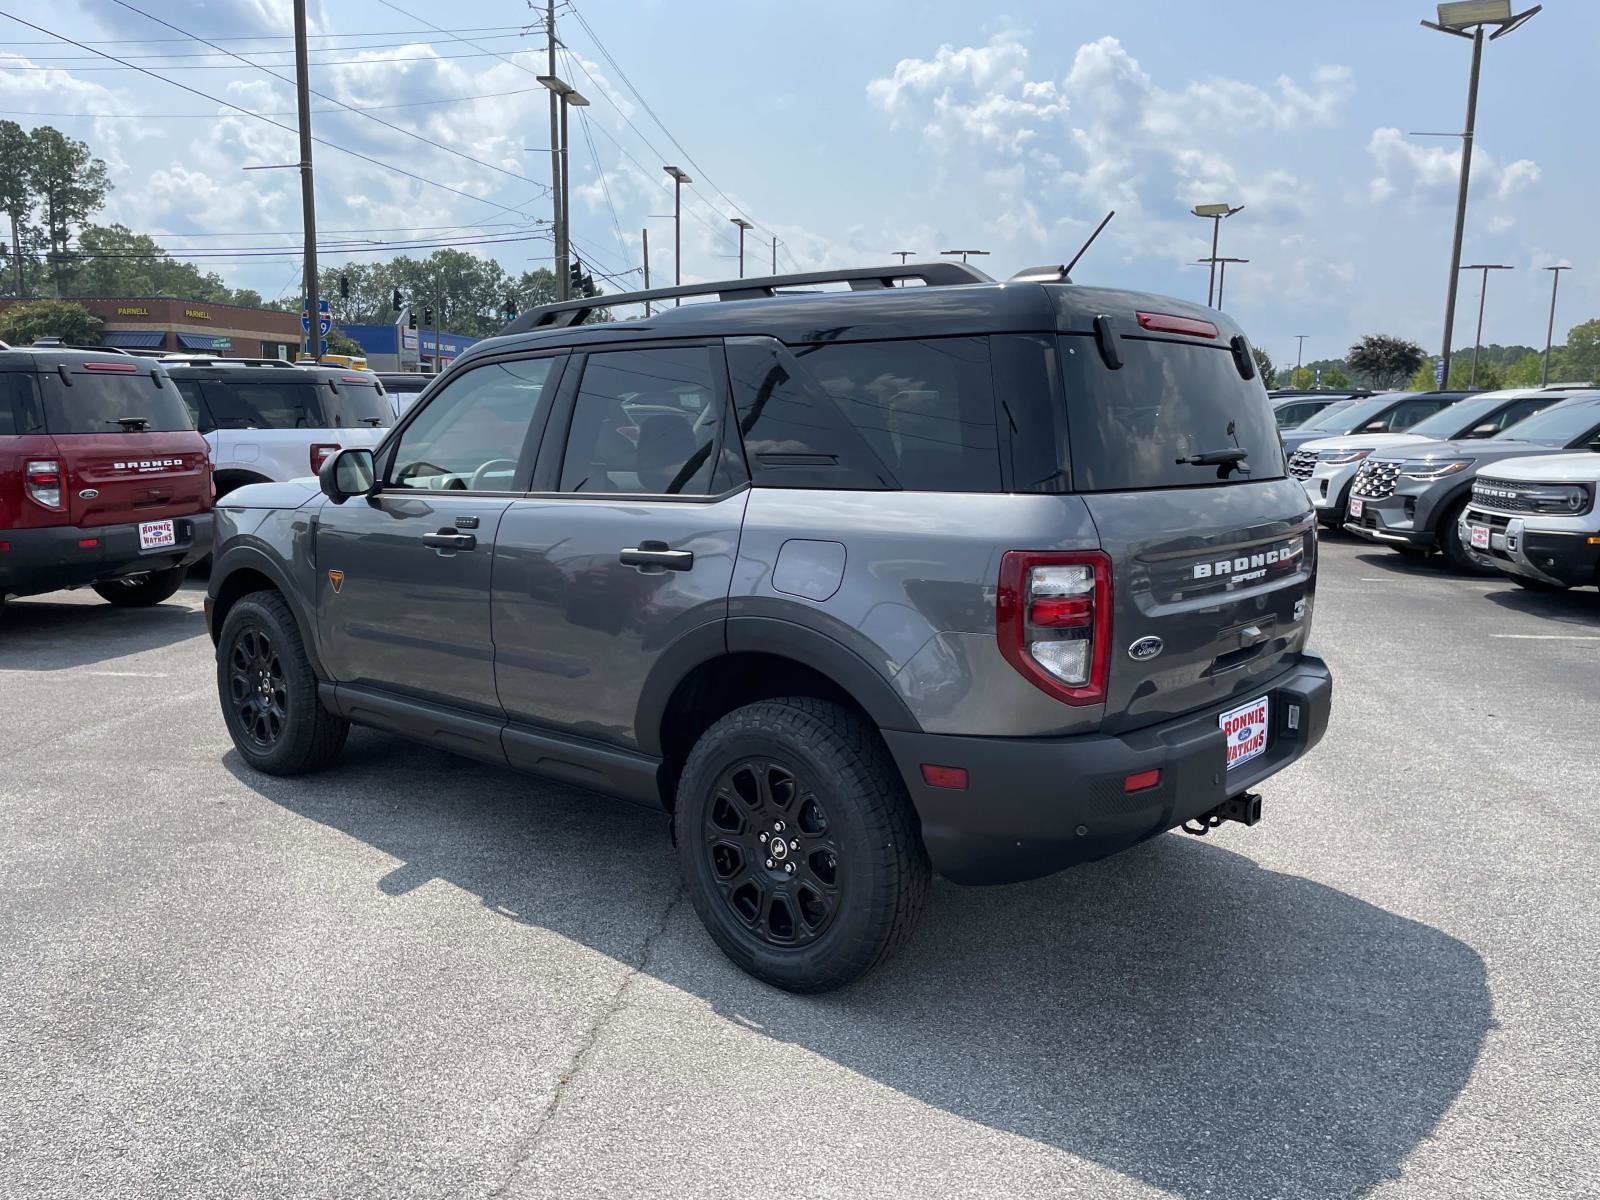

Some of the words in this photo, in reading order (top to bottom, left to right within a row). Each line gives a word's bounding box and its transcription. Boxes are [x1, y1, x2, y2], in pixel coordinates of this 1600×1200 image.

[185, 310, 210, 319] PARNELL
[113, 459, 183, 469] BRONCO
[142, 523, 171, 534] RONNIE
[143, 533, 172, 544] WATKINS
[1193, 547, 1291, 579] BRONCO
[1230, 568, 1267, 584] SPORT
[1224, 706, 1265, 736] RONNIE
